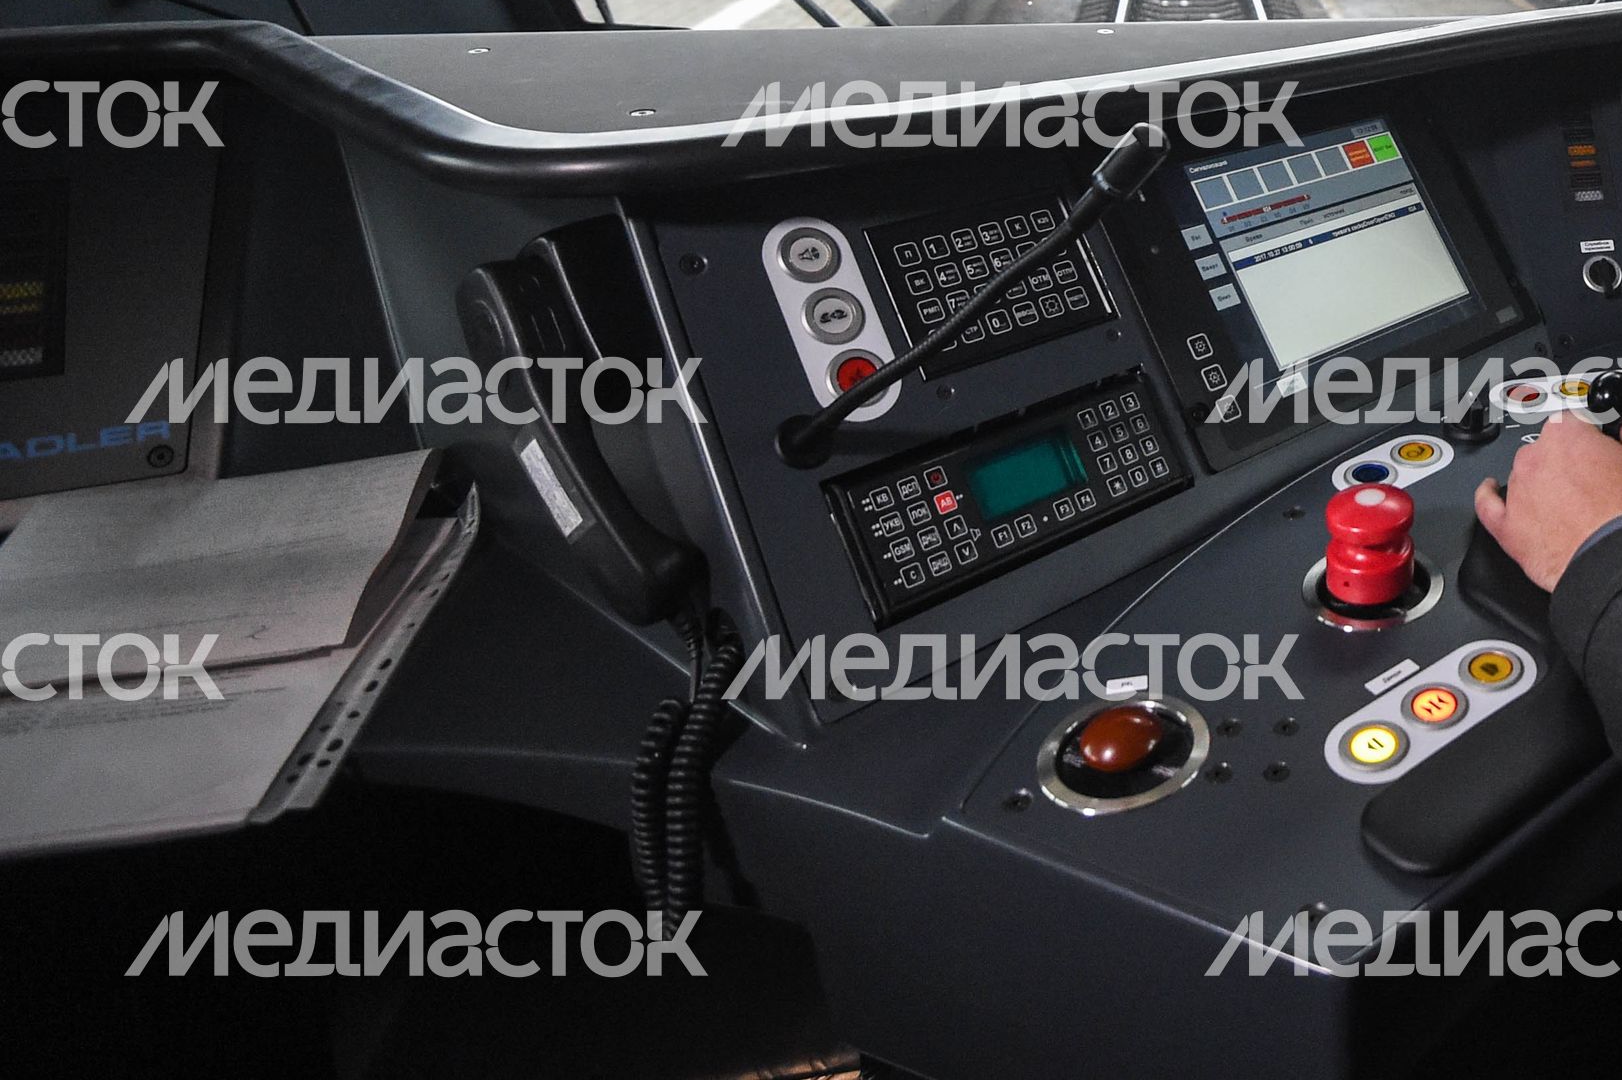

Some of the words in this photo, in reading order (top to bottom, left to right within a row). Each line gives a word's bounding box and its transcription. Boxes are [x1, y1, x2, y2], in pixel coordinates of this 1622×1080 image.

[875, 492, 889, 505] КВ
[1080, 494, 1092, 505] F4
[1059, 503, 1071, 514] F3
[883, 517, 901, 531] УКВ
[1020, 520, 1032, 532] F2
[997, 530, 1008, 542] F1
[893, 543, 912, 557] GSM
